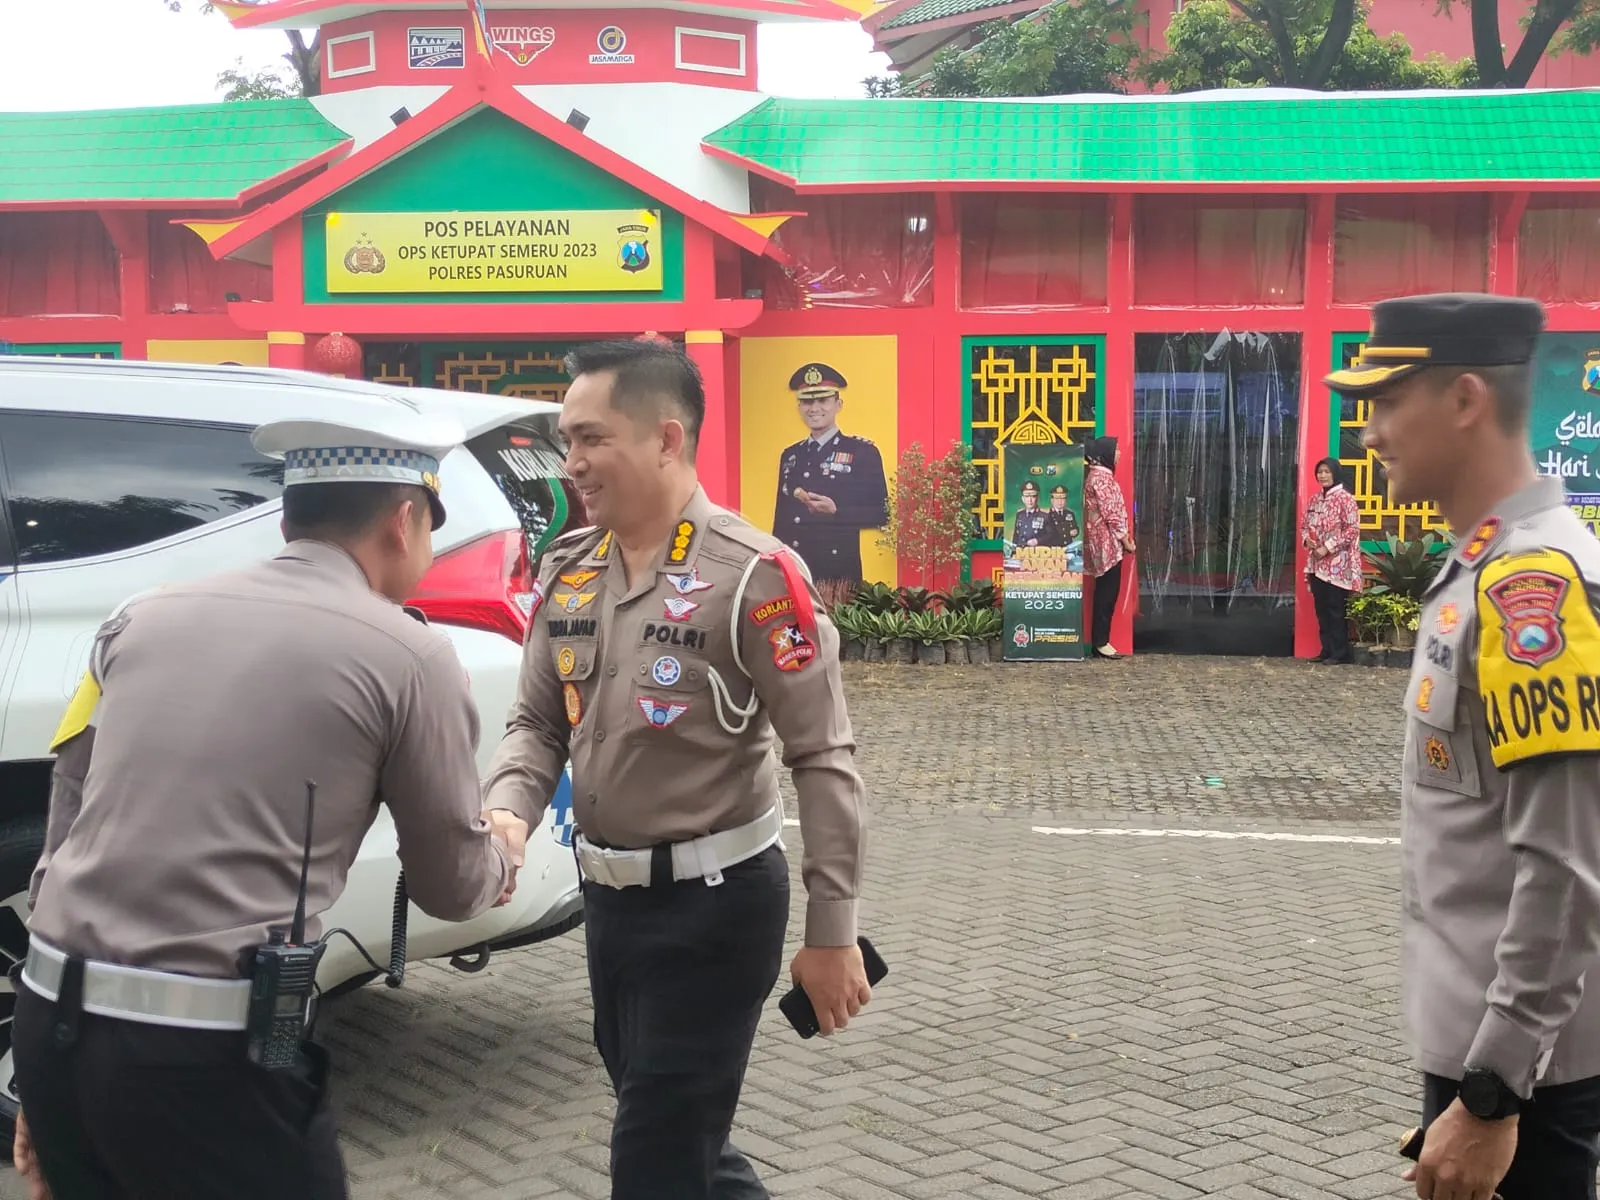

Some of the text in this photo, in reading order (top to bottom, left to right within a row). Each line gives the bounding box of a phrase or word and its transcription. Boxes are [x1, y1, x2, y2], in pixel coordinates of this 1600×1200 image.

[492, 27, 554, 42] WINGS
[424, 218, 570, 238] POS PELAYANAN
[398, 243, 597, 260] OPS KETUPAT SEMERU 2023
[429, 263, 568, 280] POLRES PASURUAN
[1538, 449, 1592, 478] Hari
[1005, 591, 1083, 599] KETUPAT SEMERU
[753, 599, 795, 622] KORLANT
[1024, 600, 1065, 610] 2023
[643, 622, 707, 650] POLRI
[1509, 675, 1571, 740] OPS
[1576, 673, 1600, 733] R
